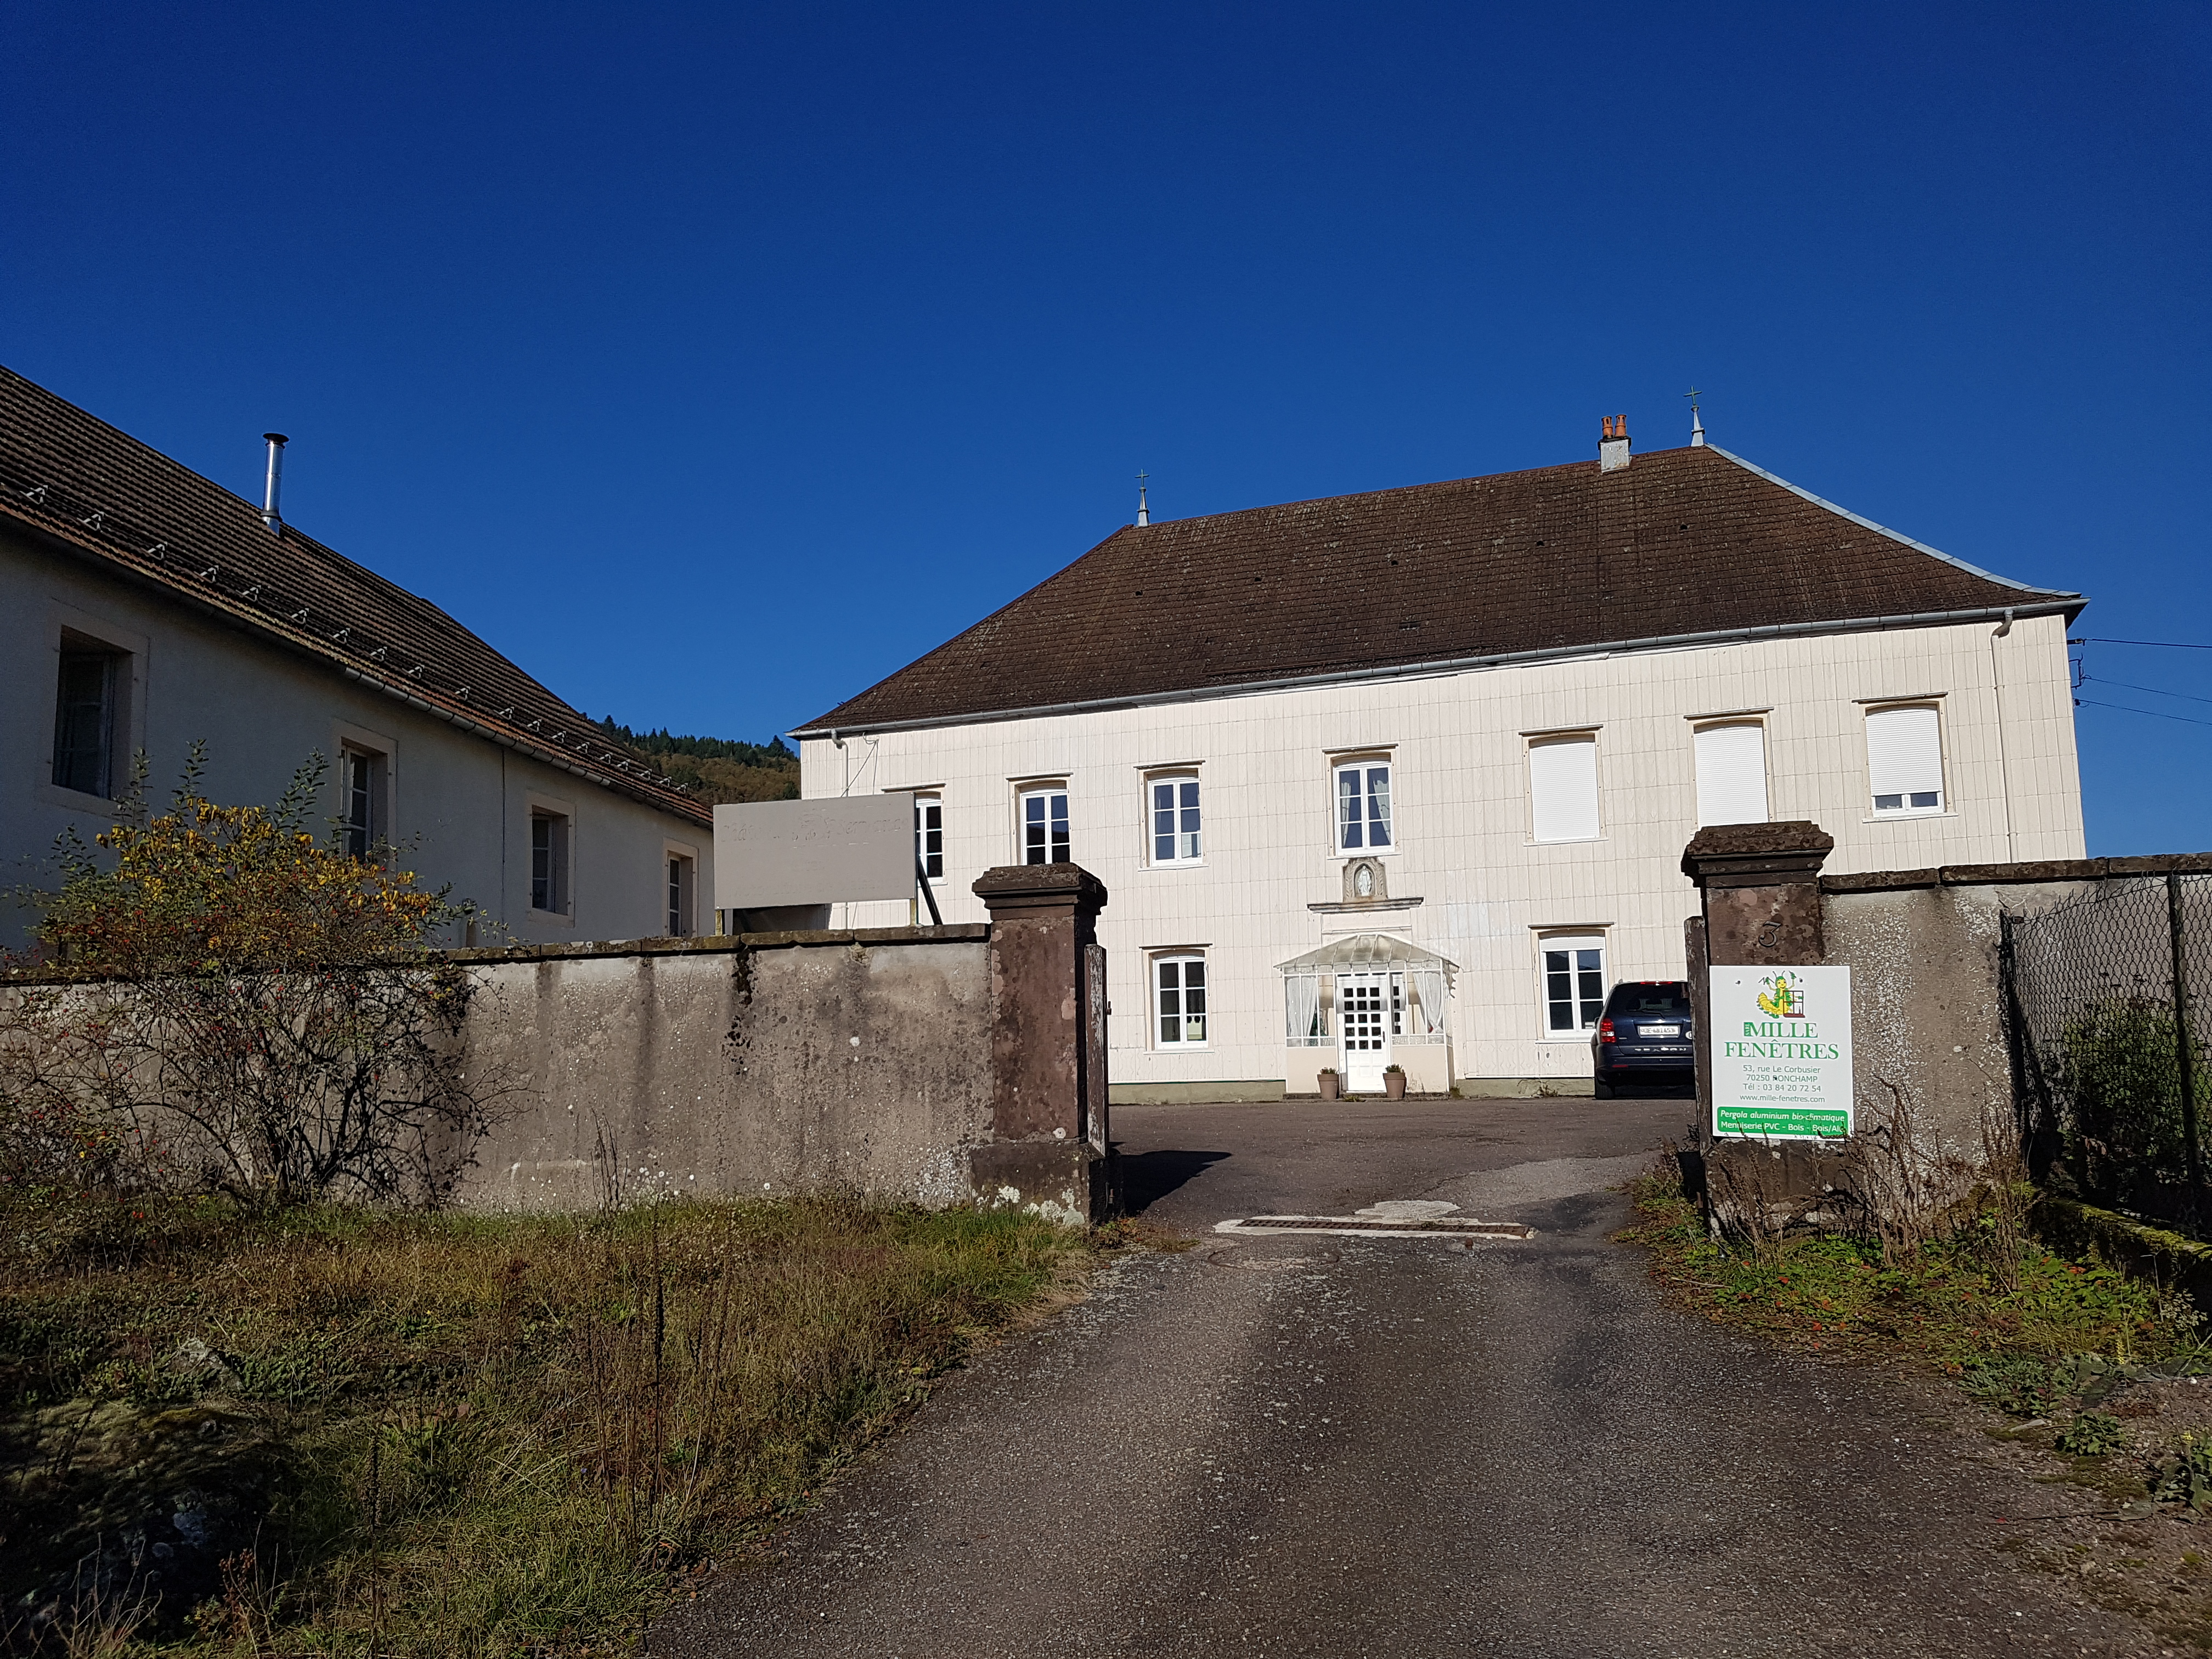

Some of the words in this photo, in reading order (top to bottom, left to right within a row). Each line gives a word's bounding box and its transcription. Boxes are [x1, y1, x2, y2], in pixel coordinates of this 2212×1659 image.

[1758, 921, 1782, 948] 3
[1748, 1022, 1818, 1038] MILLE
[1724, 1039, 1839, 1060] FENÊTRES
[1743, 1065, 1755, 1073] 53,
[1740, 1094, 1825, 1103] www.mille-fenetres.com
[1720, 1110, 1748, 1120] Pergola
[1750, 1111, 1790, 1120] aluminium
[1720, 1121, 1762, 1130] Menuiserie
